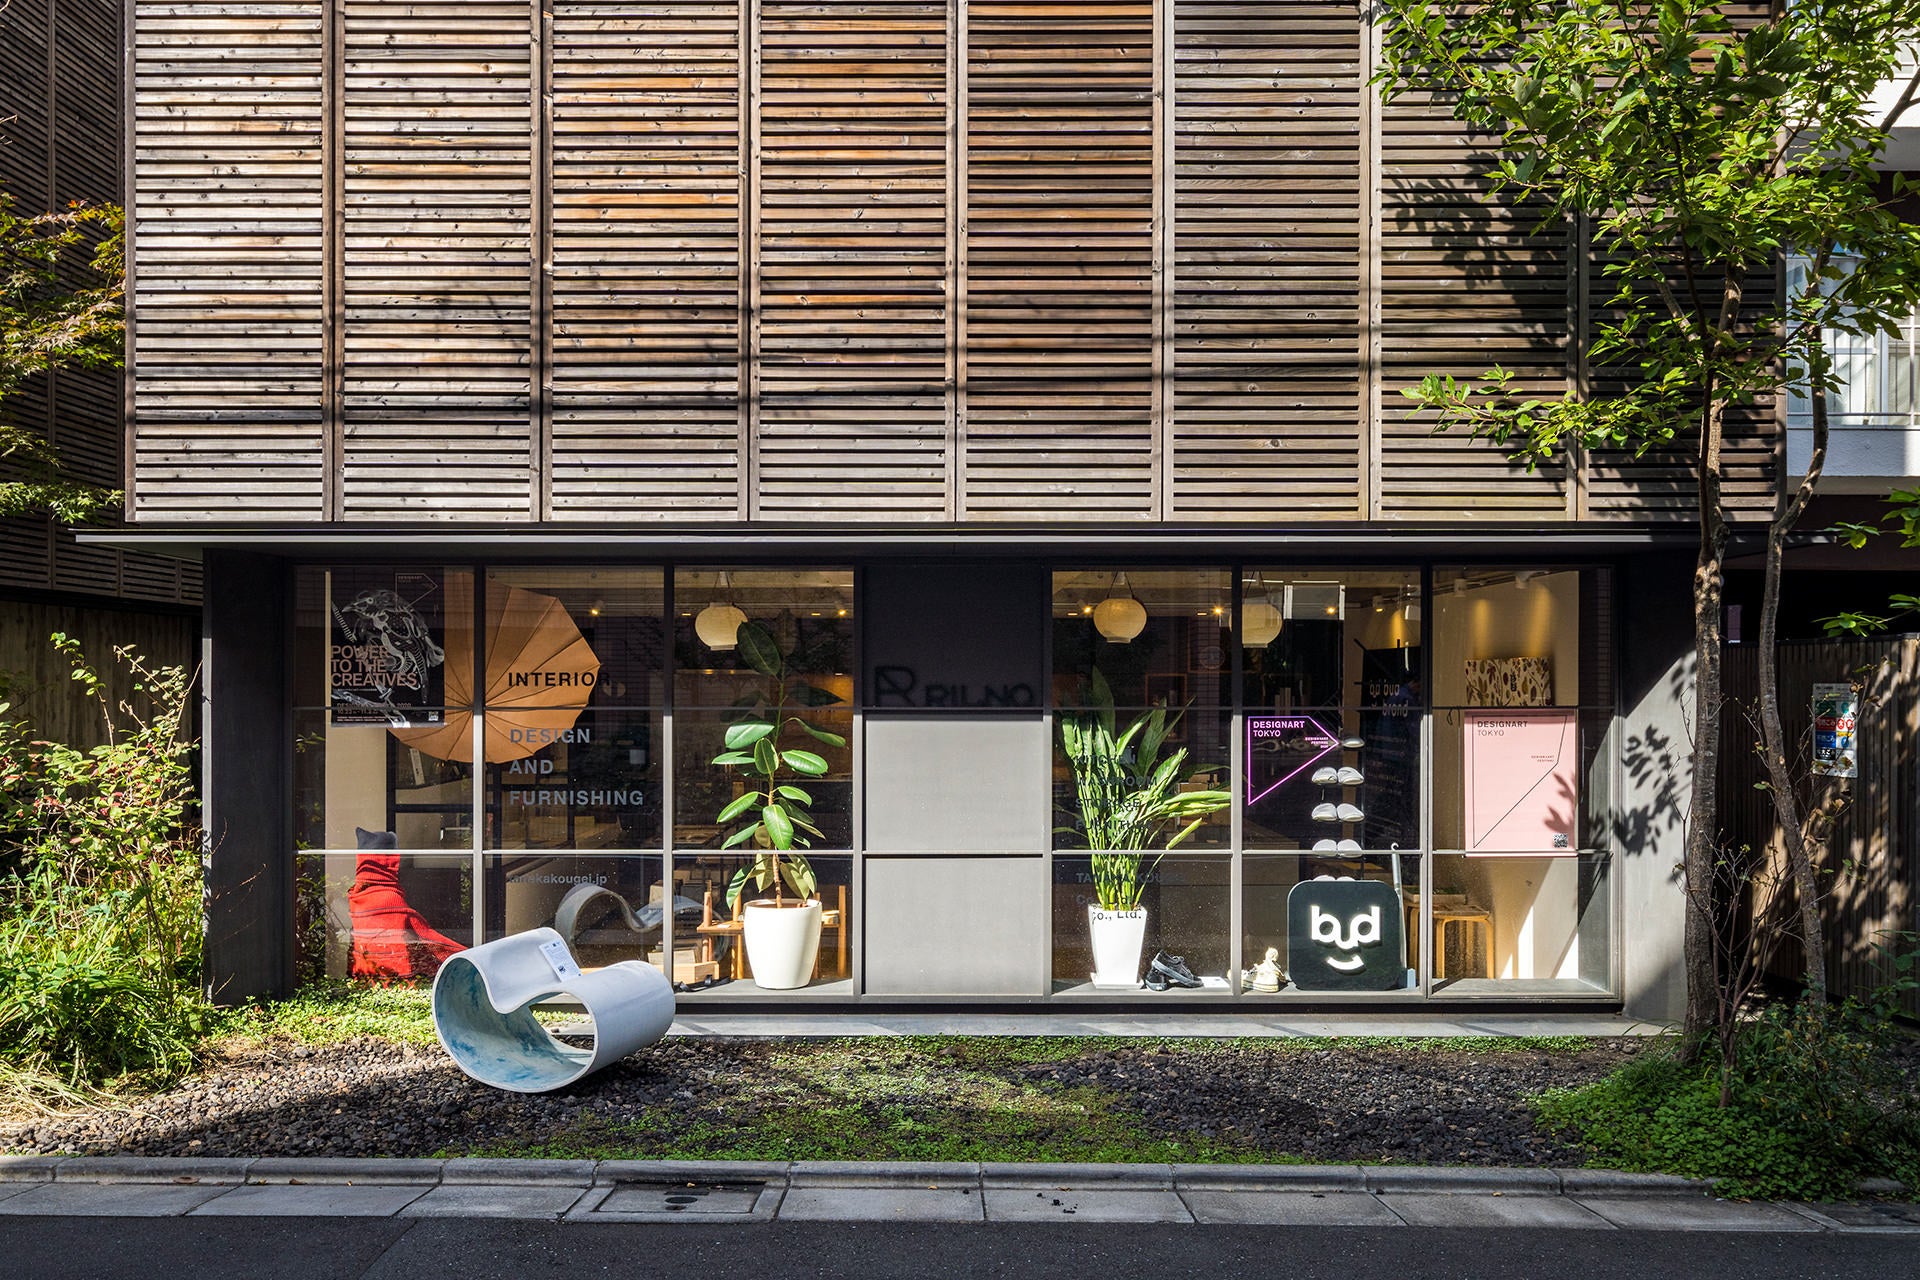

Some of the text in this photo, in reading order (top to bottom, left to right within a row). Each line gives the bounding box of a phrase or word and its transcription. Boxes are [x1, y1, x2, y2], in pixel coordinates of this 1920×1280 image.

[331, 645, 389, 659] POWER
[331, 659, 387, 673] TO THE
[331, 673, 417, 687] CREATIVES
[508, 672, 610, 687] INTERIOR
[1253, 721, 1305, 729] DESIGNART
[510, 728, 590, 743] DESIGN
[1253, 729, 1281, 737] TOKYO
[1477, 729, 1505, 737] TOKYO
[509, 759, 554, 775] AND
[509, 790, 644, 806] FURNISHING
